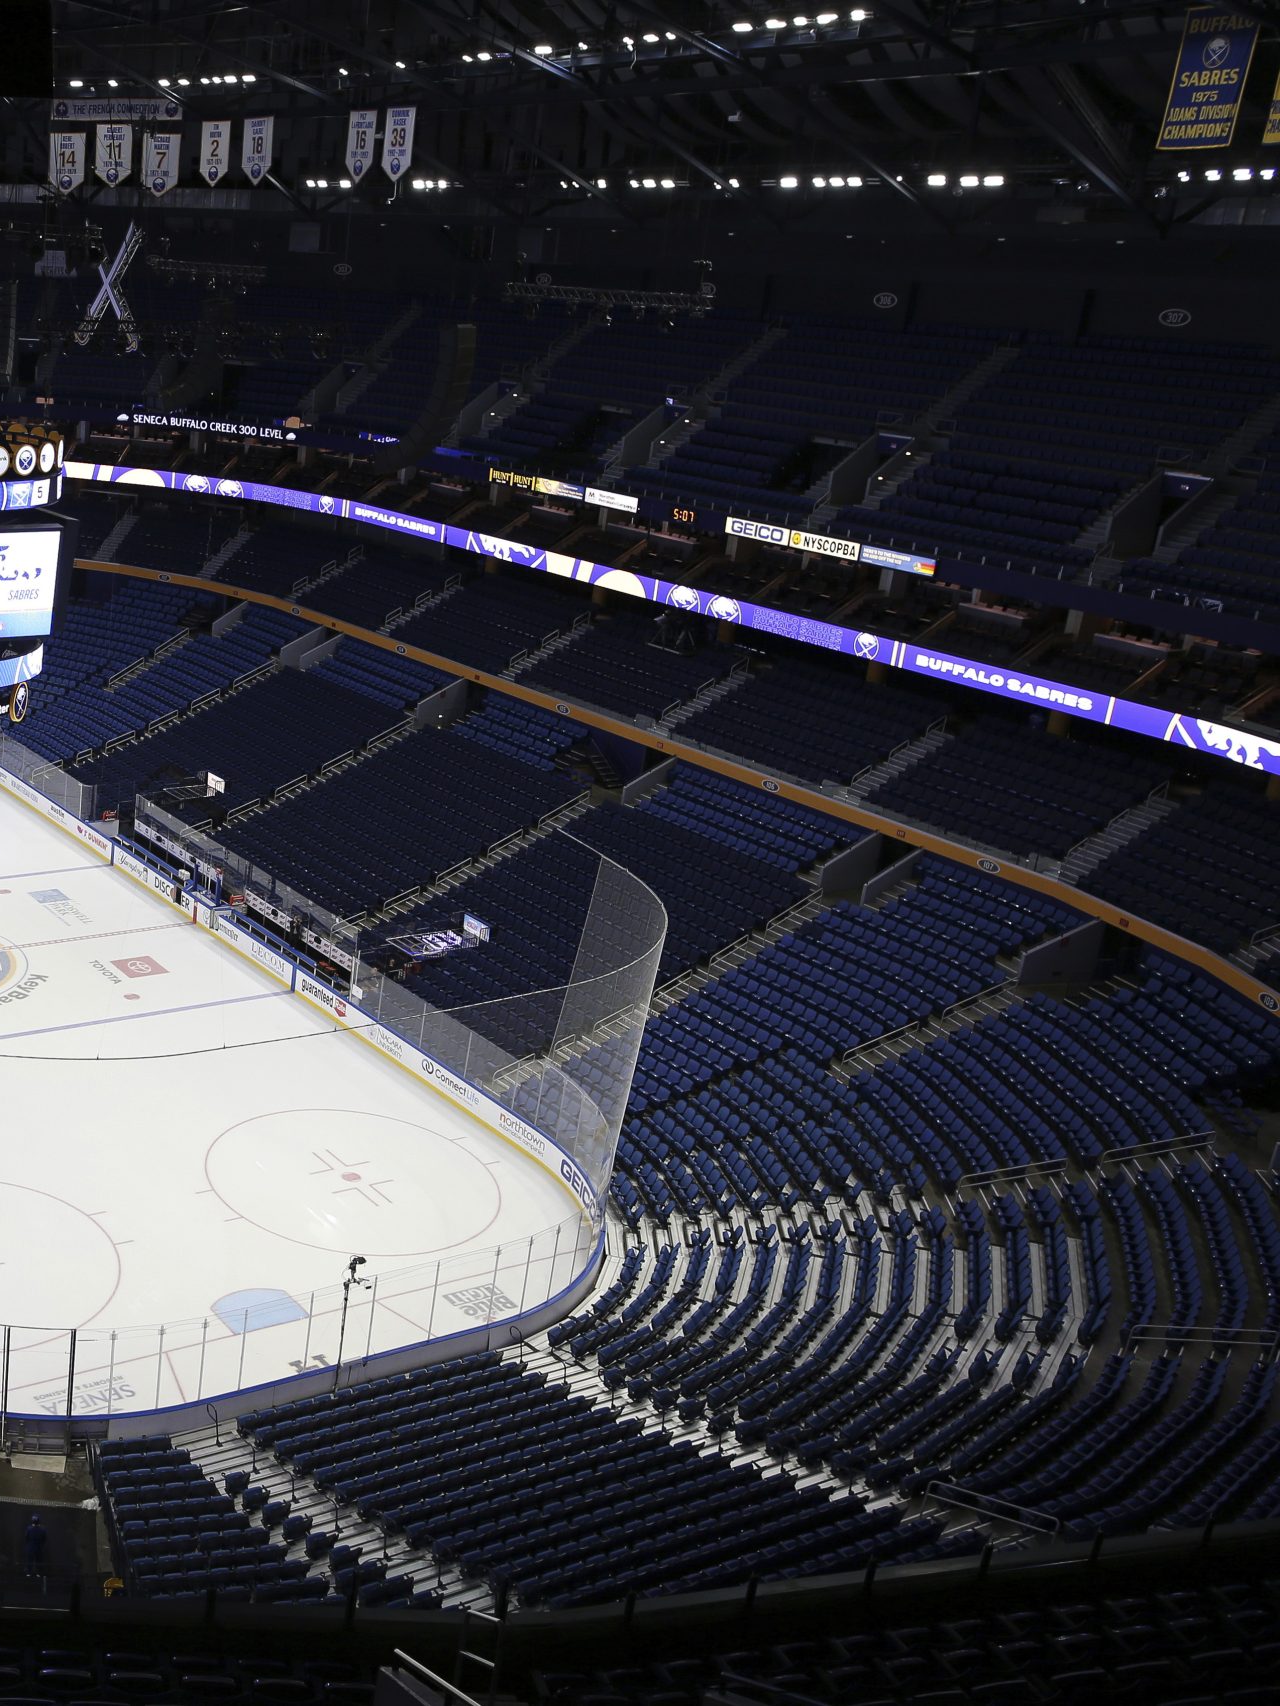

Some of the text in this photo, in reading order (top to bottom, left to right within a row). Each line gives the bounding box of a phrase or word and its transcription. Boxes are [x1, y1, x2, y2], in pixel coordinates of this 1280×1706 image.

[1179, 68, 1240, 88] SABRES
[1191, 91, 1219, 103] 1975
[73, 104, 85, 115] THE
[89, 104, 115, 115] FRENCH
[1167, 107, 1198, 122] ADAMS
[355, 130, 366, 149] 16
[391, 128, 406, 147] 39
[1163, 122, 1231, 140] CHAMPIONS
[106, 142, 122, 160] 11
[210, 139, 219, 157] 2
[252, 136, 263, 154] 18
[59, 151, 76, 167] 14
[156, 152, 166, 169] 7
[1166, 312, 1184, 322] 307
[133, 414, 283, 440] SENECA BUFFALO CREEK 300 LEVEL
[37, 487, 43, 499] 5
[354, 506, 425, 535] BUFFALO SABRES
[673, 508, 695, 522] 5:07
[731, 520, 856, 557] GEICO NYSCOPBA
[8, 588, 40, 601] SABRES
[915, 654, 1093, 711] BUFFALO SABRES
[88, 832, 108, 851] DUNKIN'
[119, 850, 143, 878] Yuengling
[154, 877, 190, 911] DISCOER
[251, 942, 286, 973] LECOM
[88, 959, 123, 984] TOYOTA
[301, 978, 334, 1008] guaranteed
[376, 1036, 402, 1060] UNIVERSITY
[377, 1028, 403, 1053] NIAGARA
[499, 1112, 546, 1151] northtown
[560, 1159, 596, 1221] GEICO
[446, 1284, 502, 1306] LIGHT
[458, 1295, 519, 1317] Blue
[33, 1389, 72, 1401] ASINOS
[40, 1384, 136, 1415] SENECA
